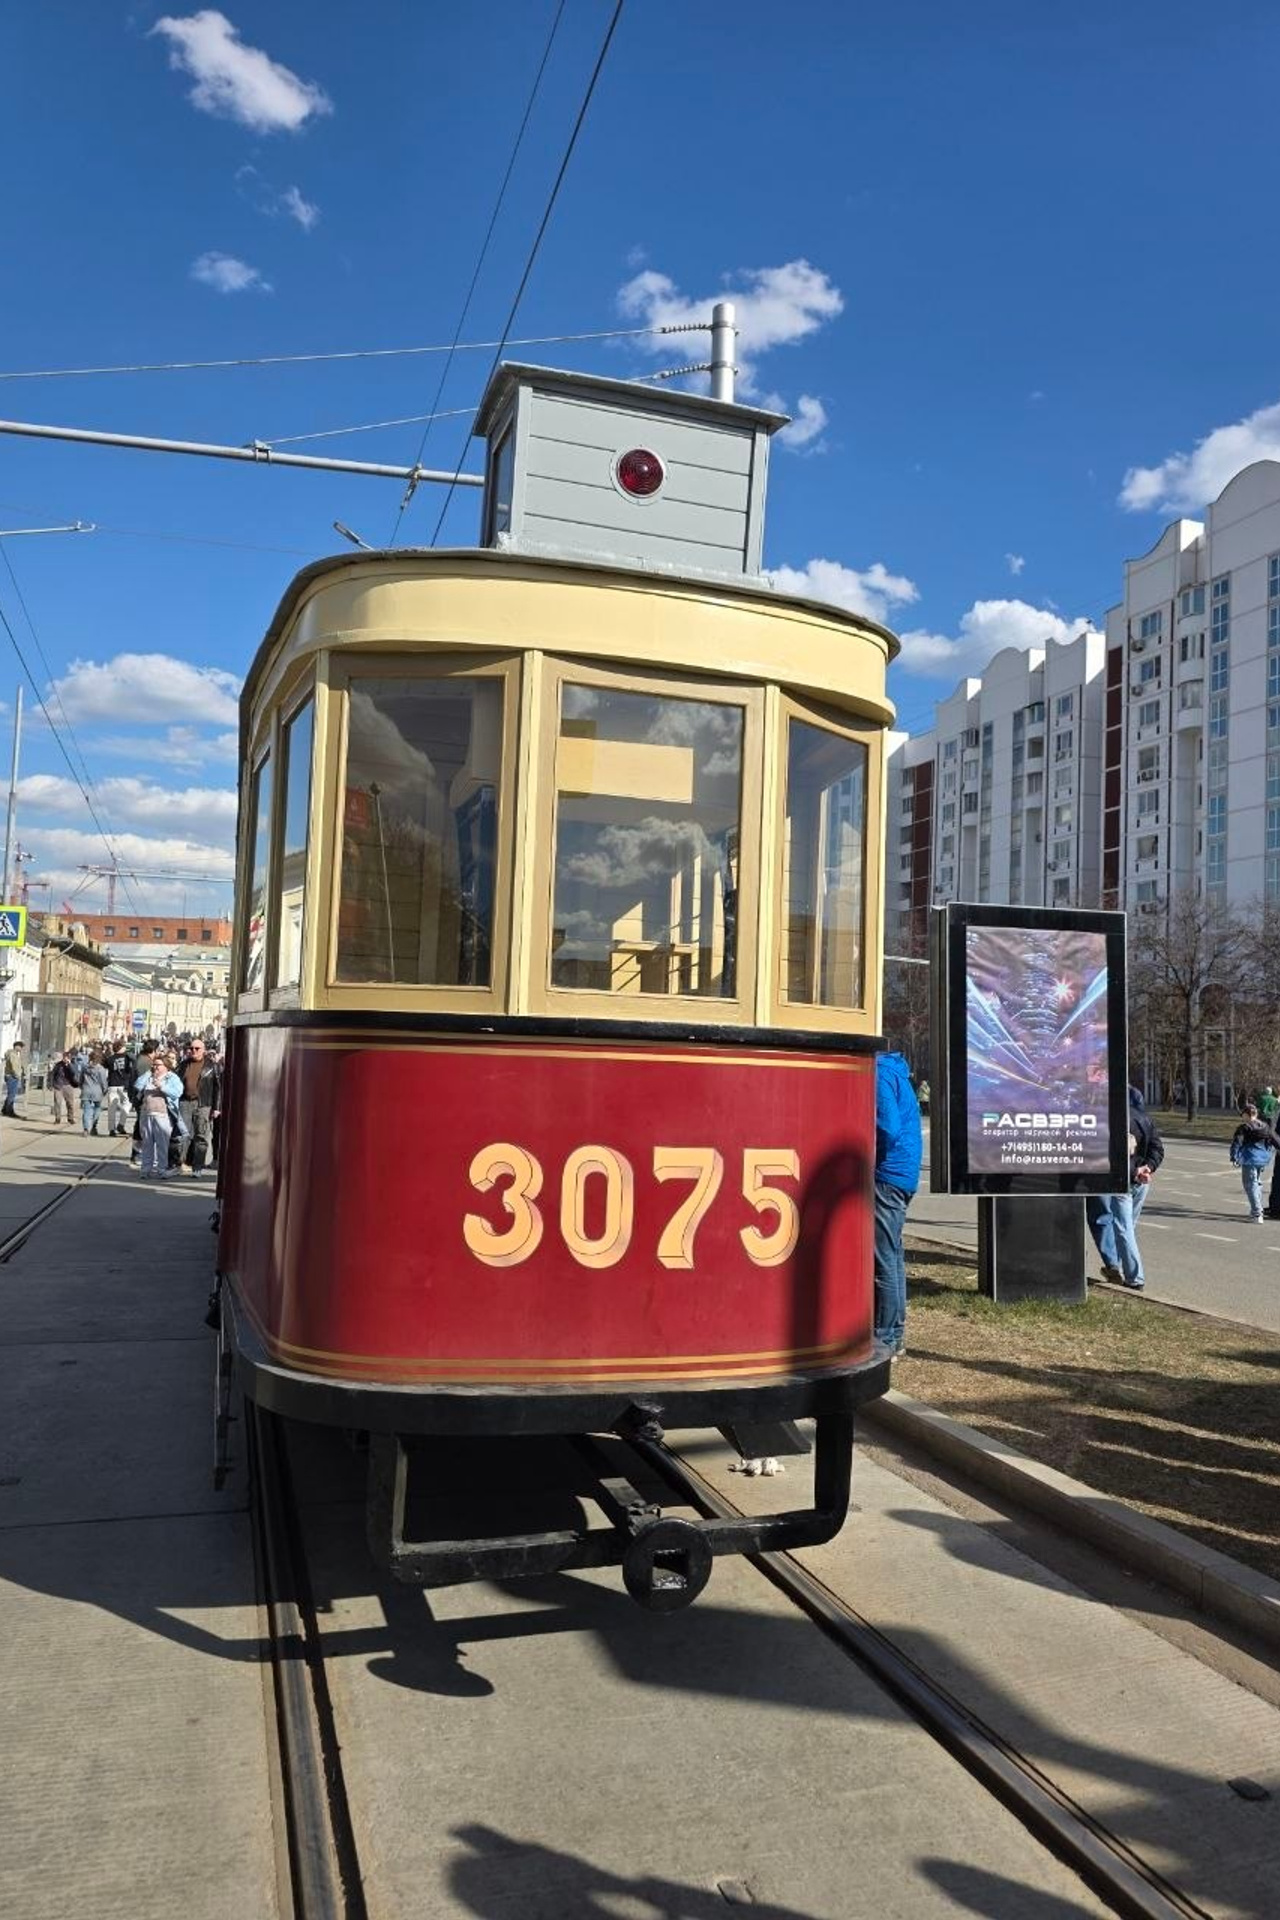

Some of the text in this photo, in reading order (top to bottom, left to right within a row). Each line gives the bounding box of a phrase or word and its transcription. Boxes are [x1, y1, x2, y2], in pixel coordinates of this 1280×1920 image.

[982, 1113, 1097, 1128] РАСВЭРО
[1001, 1154, 1084, 1165] info@rasvero.ru
[463, 1142, 800, 1269] 3075
